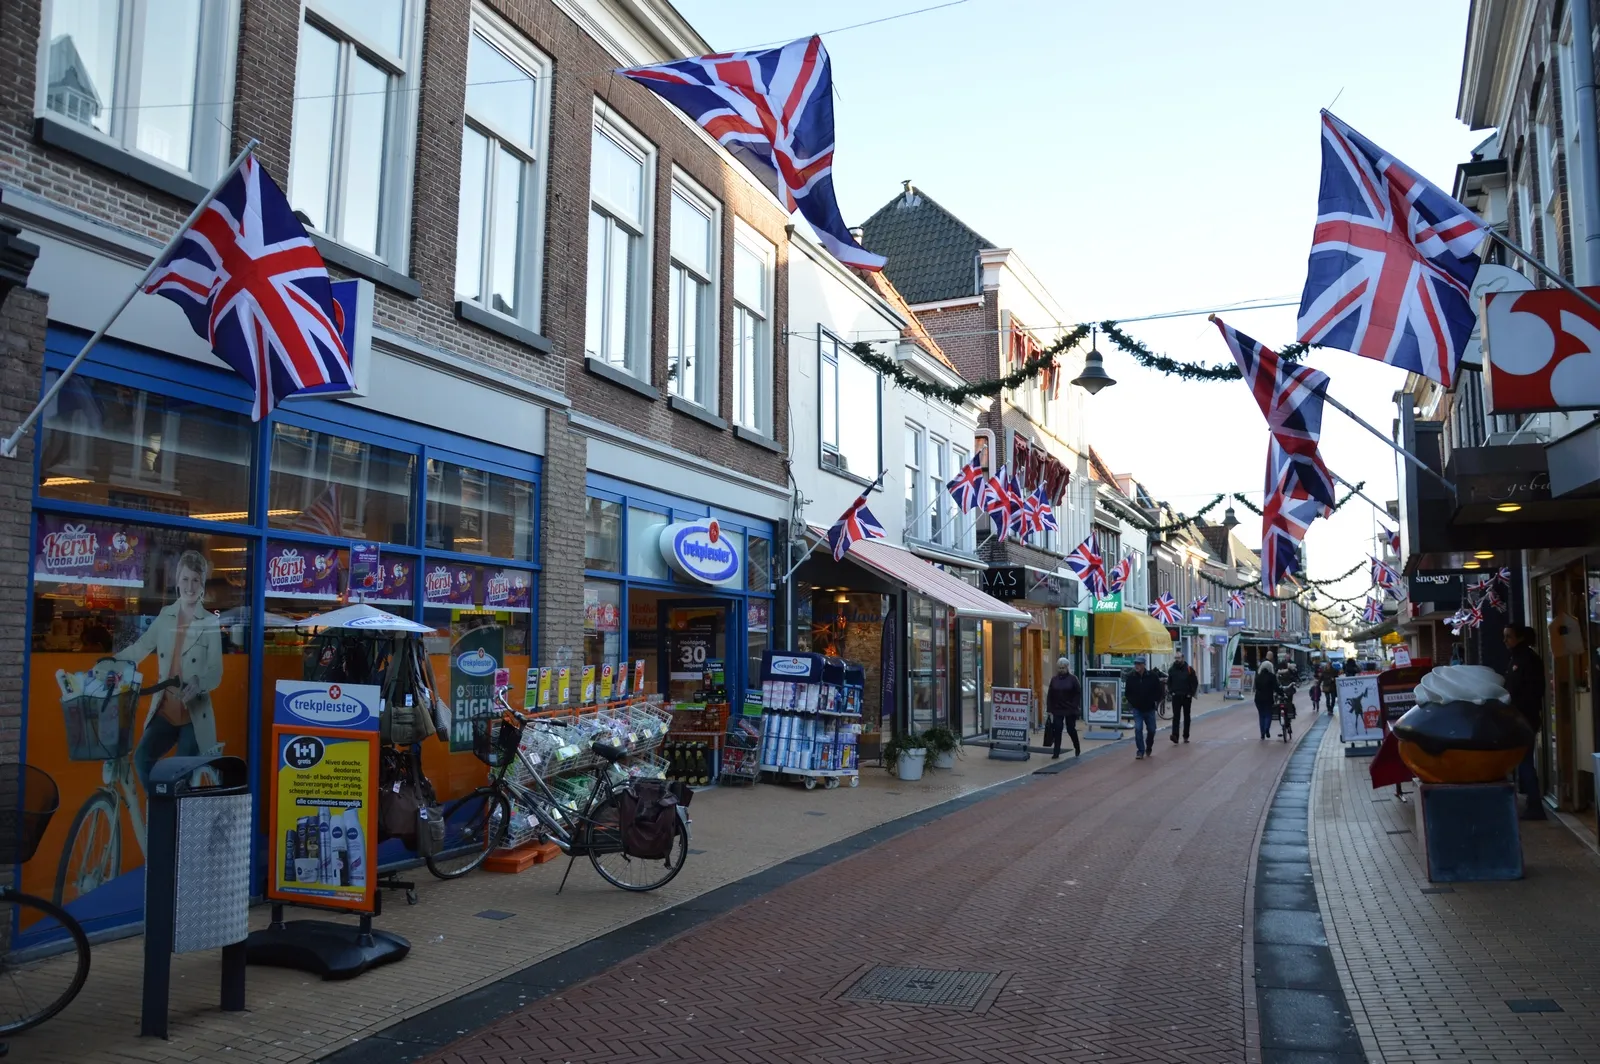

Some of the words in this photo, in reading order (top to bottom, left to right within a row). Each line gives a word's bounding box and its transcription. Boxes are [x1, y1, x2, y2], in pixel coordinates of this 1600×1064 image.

[46, 534, 96, 557] Kerst
[684, 540, 730, 563] trekpleister
[47, 557, 72, 567] VOOR
[74, 555, 93, 565] JOU!
[273, 558, 303, 577] Kerst
[272, 576, 289, 586] VOOR
[289, 575, 303, 584] JOU!
[428, 573, 451, 590] Kerst
[490, 579, 509, 594] Kerst
[680, 646, 706, 663] 30
[462, 659, 492, 668] trekpleister
[776, 662, 805, 672] trekpleister
[465, 684, 488, 697] STERK
[994, 692, 1028, 704] SALE
[294, 699, 358, 713] trekpleister
[995, 705, 1001, 713] 2
[996, 729, 1025, 738] BENNEN
[293, 743, 316, 758] 1+1
[293, 781, 333, 789] haarverzorging
[338, 800, 361, 808] mogelijk
